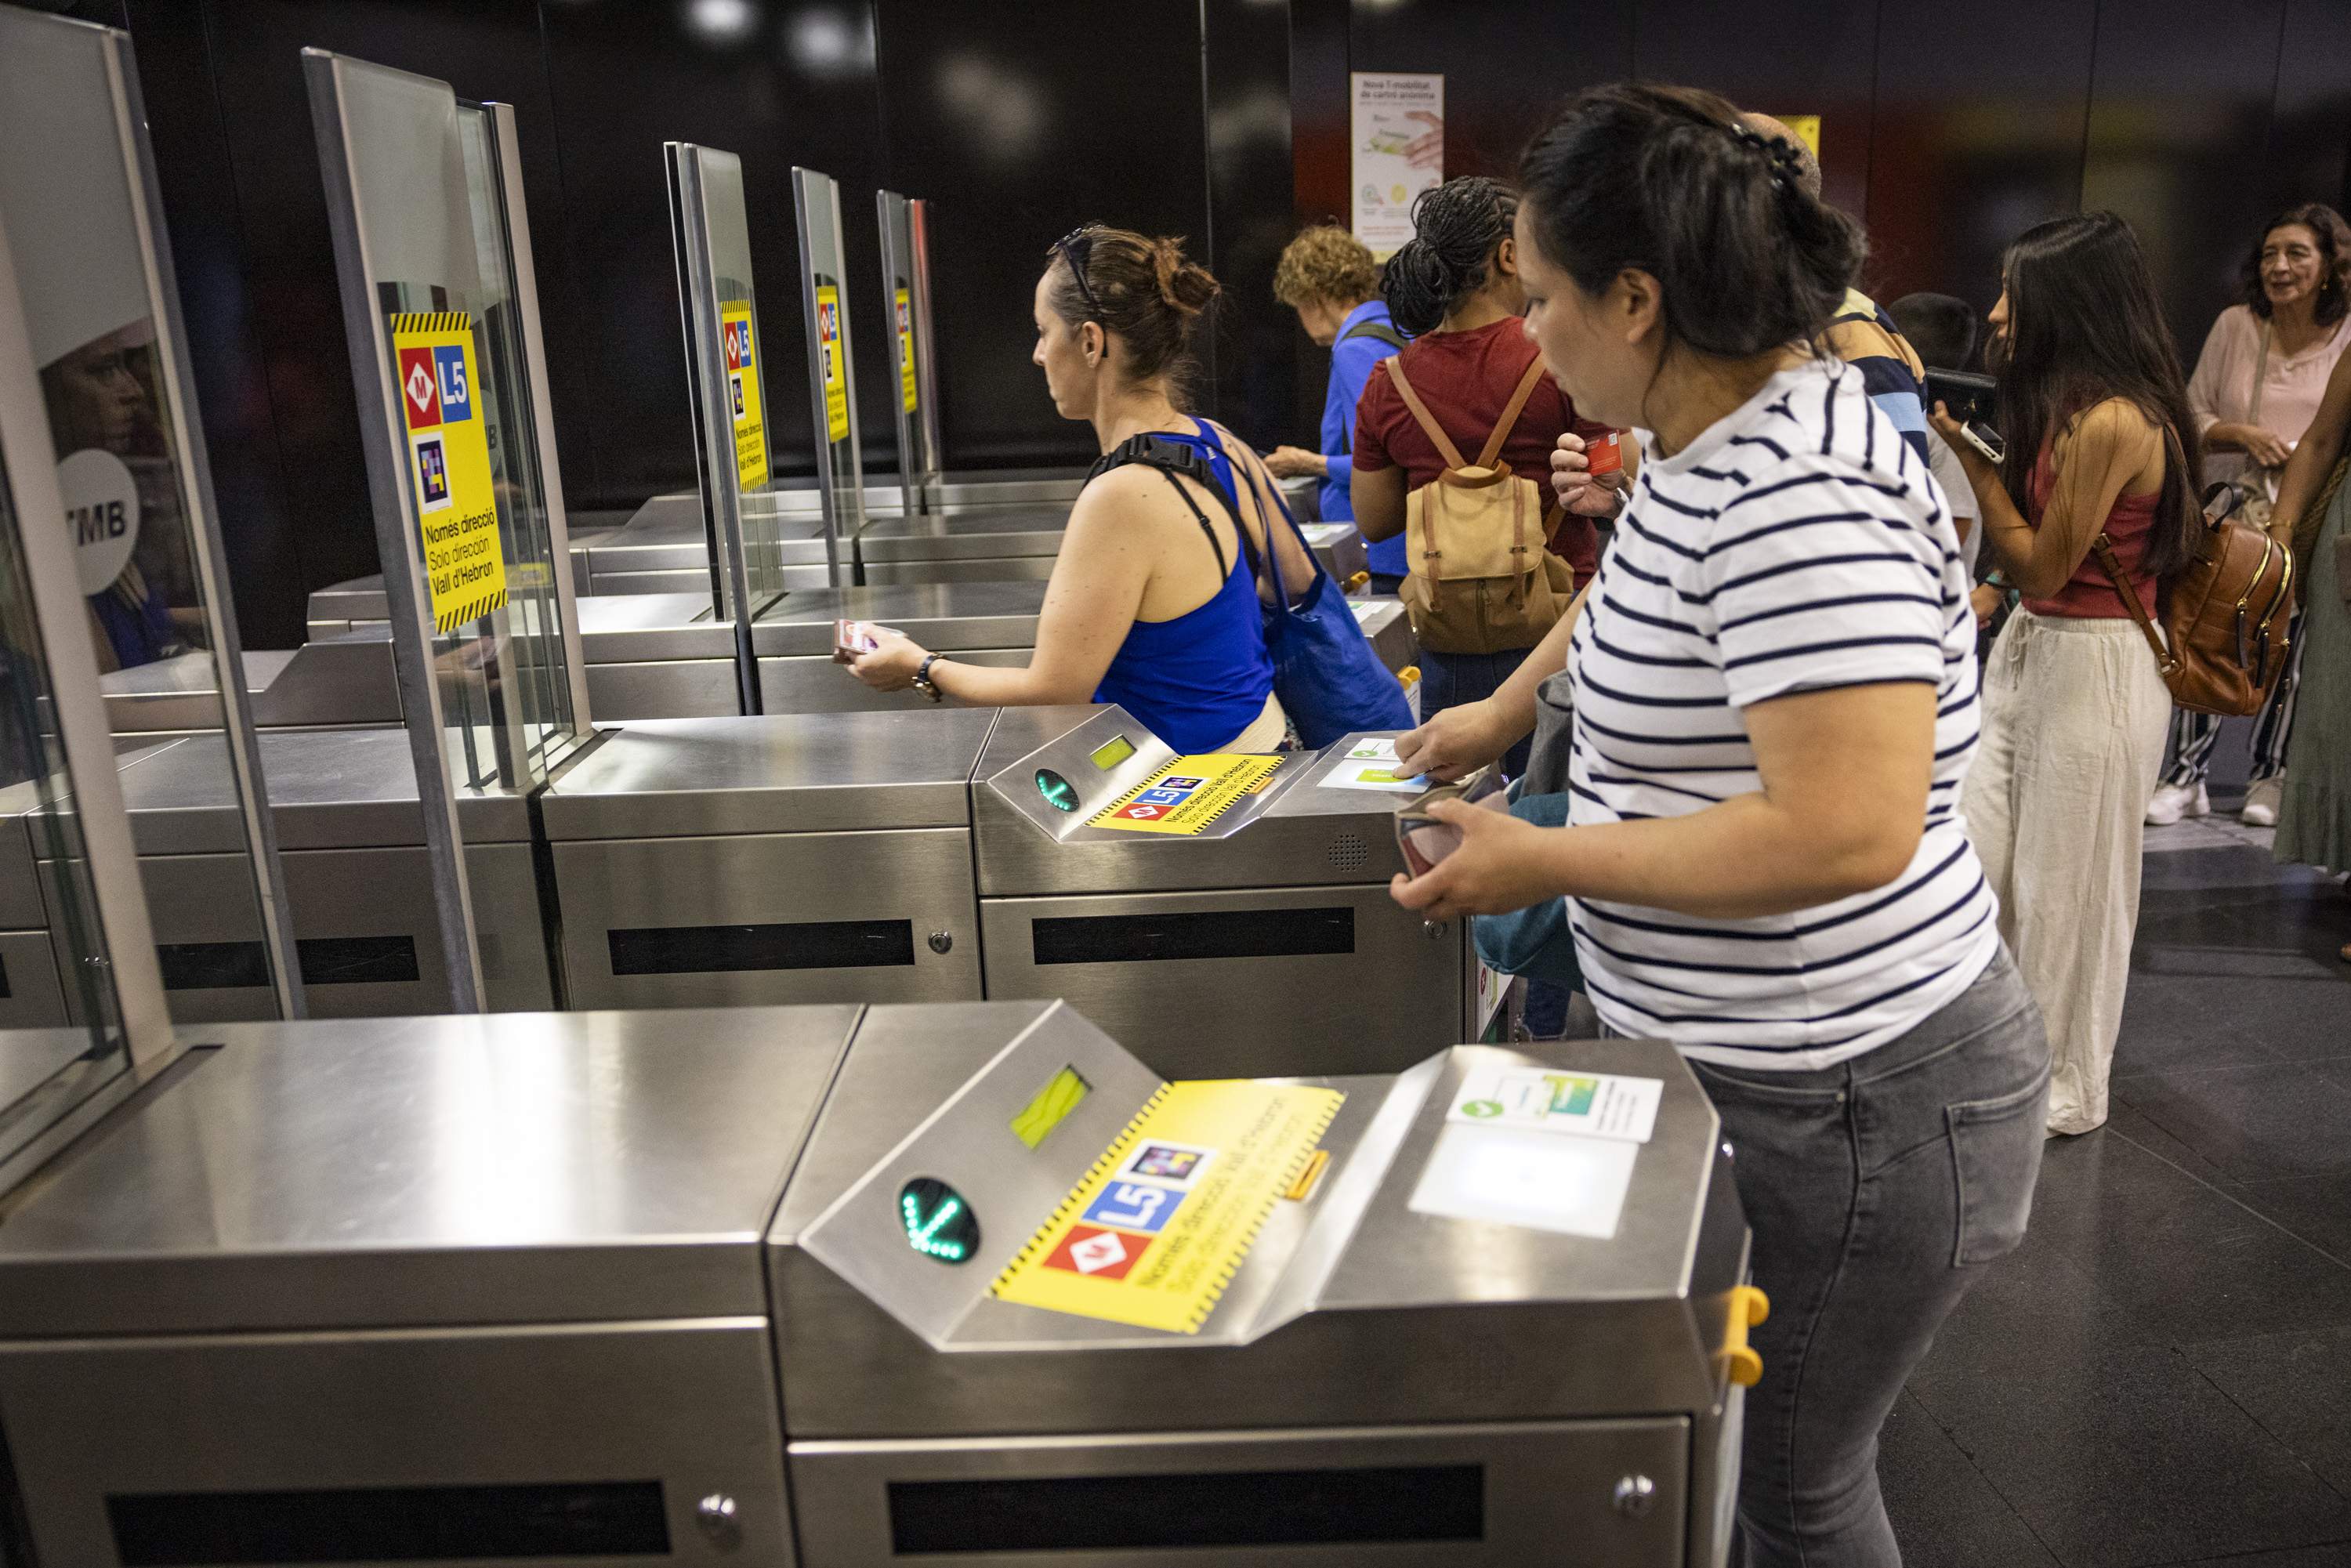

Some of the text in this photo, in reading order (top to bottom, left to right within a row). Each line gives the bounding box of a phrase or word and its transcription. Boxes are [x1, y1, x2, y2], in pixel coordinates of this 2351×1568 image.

[738, 330, 750, 357] L5
[414, 375, 427, 400] M
[438, 361, 467, 405] L5
[67, 499, 125, 547] MB
[426, 507, 494, 545] Només direcció
[429, 535, 490, 571] Solo dirección
[433, 561, 494, 596] Vall d'Hebron
[1143, 791, 1180, 804] L5
[1097, 1184, 1167, 1227] L5
